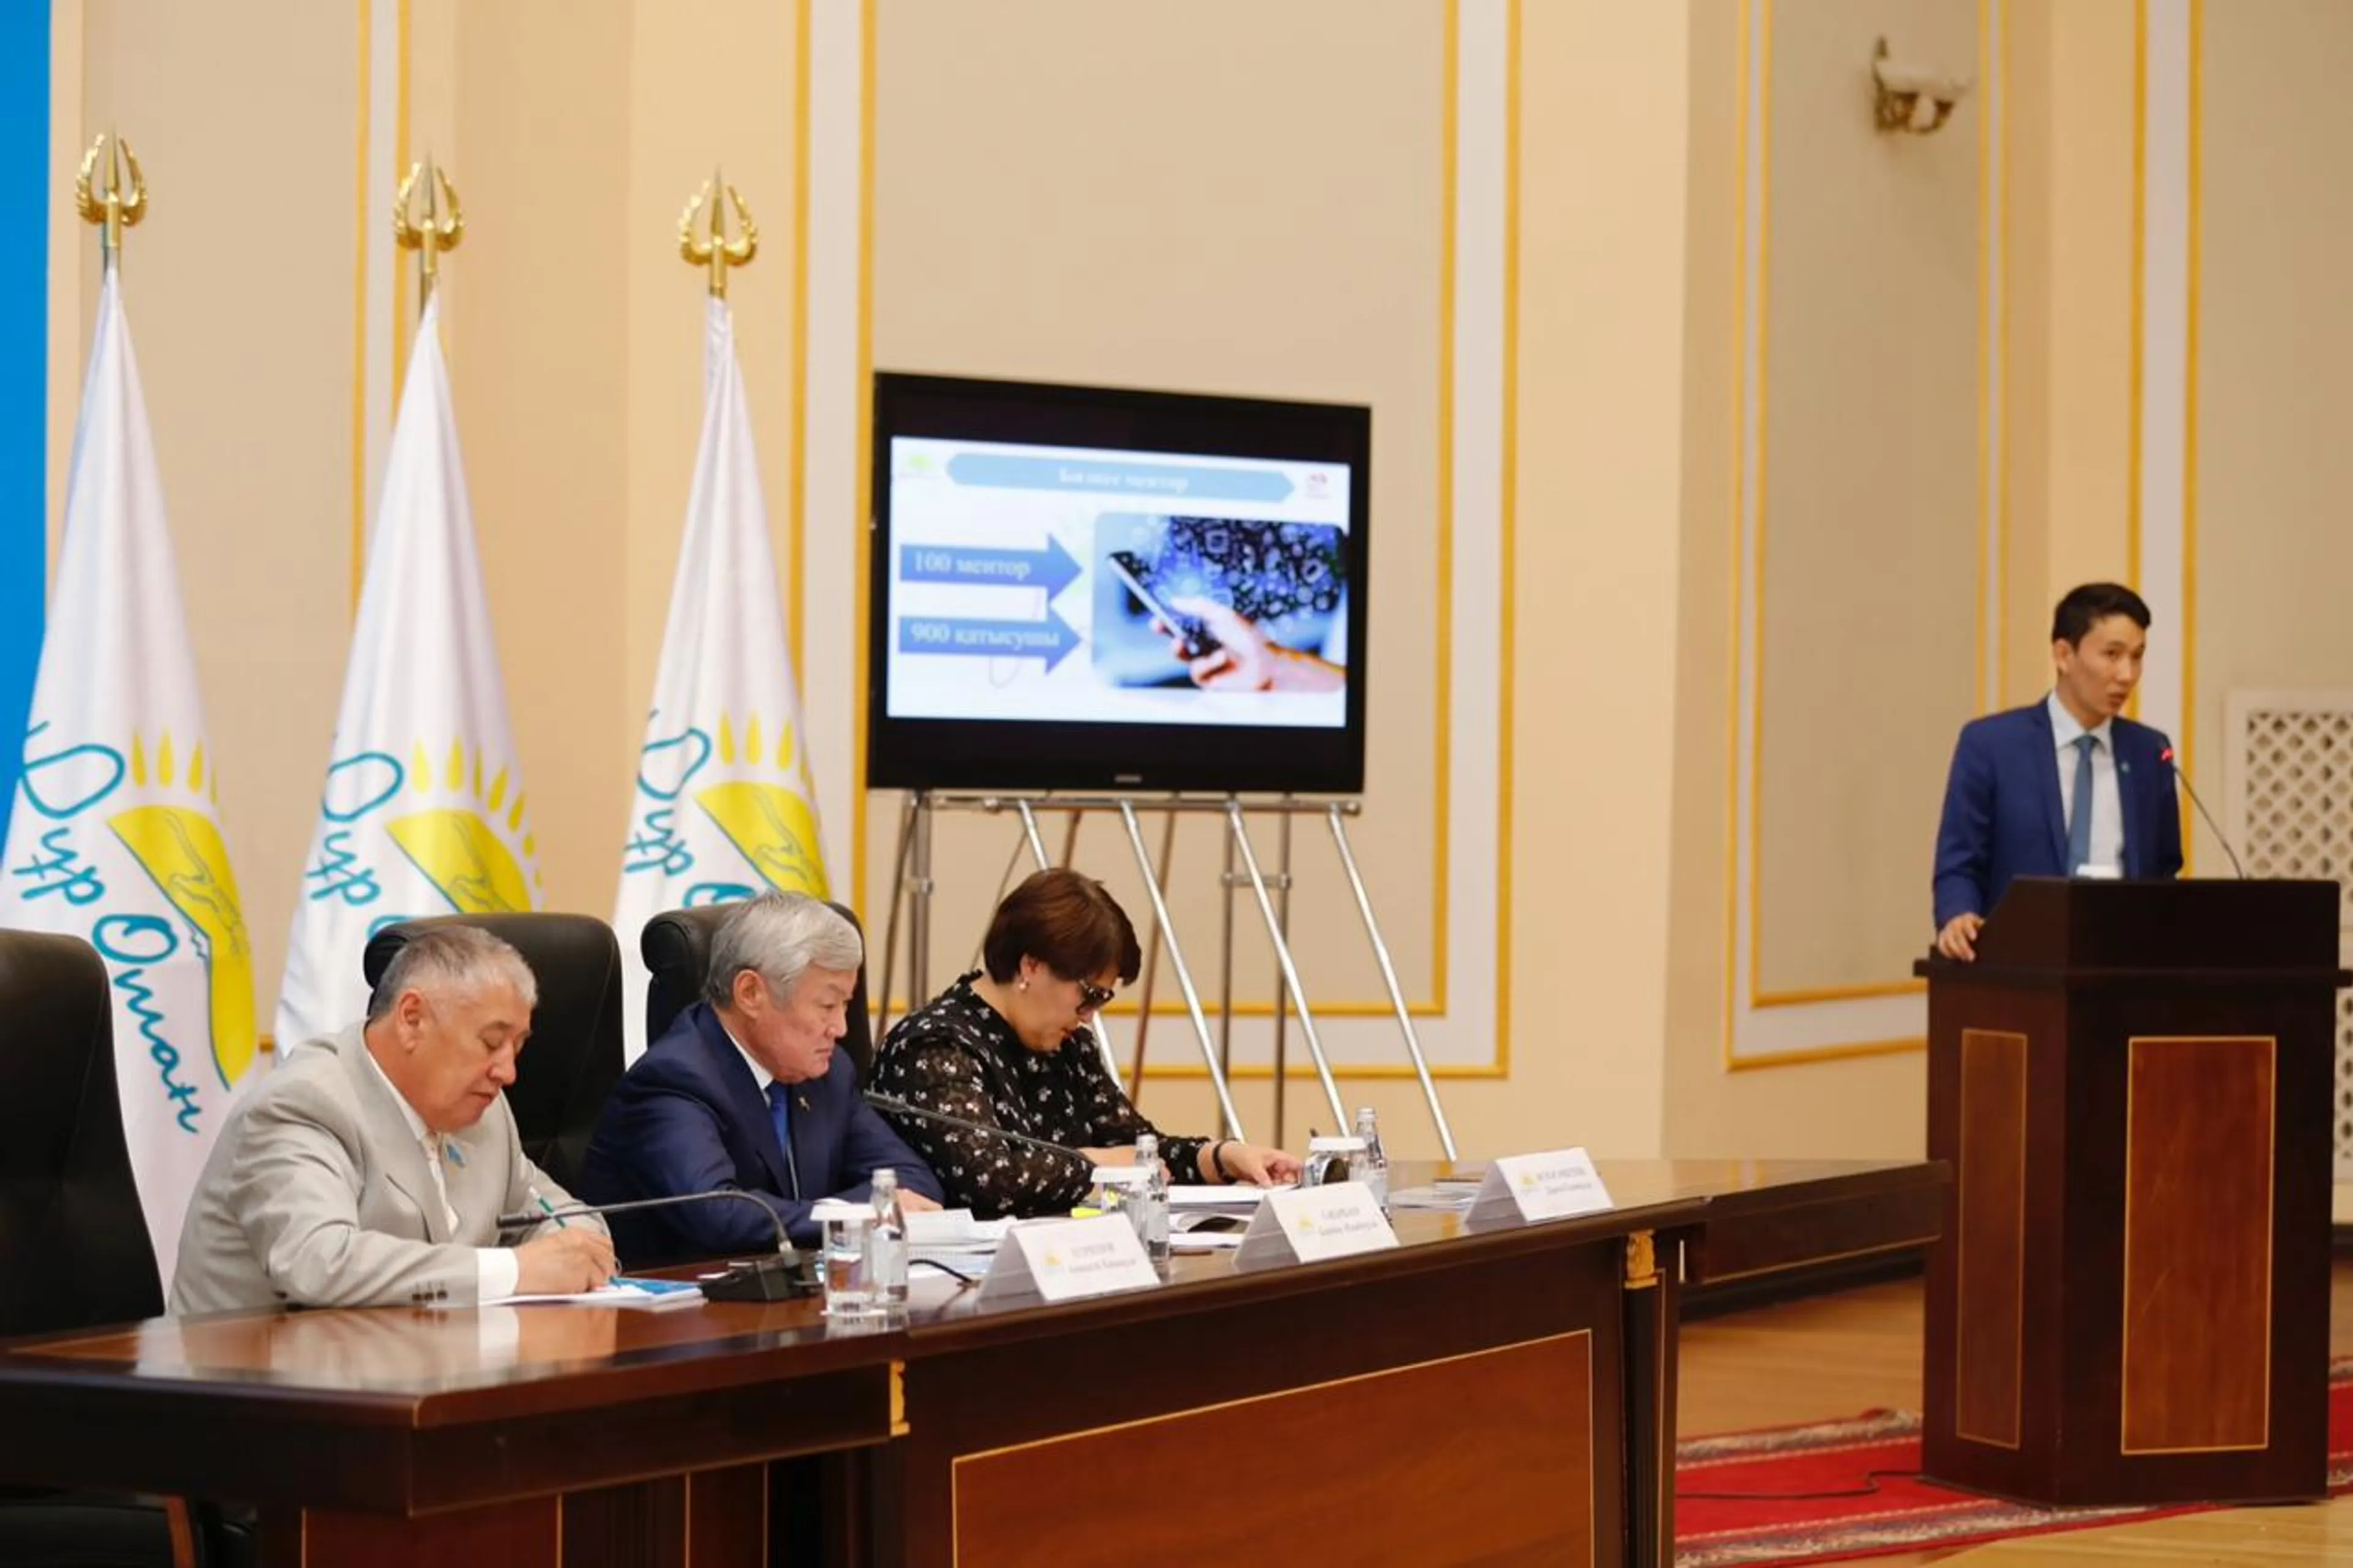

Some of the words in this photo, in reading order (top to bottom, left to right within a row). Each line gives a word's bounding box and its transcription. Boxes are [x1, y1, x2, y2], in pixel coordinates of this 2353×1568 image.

[914, 554, 952, 576] 100
[956, 562, 1031, 581] ментор
[911, 625, 950, 646] 900
[91, 913, 201, 1134] Отан
